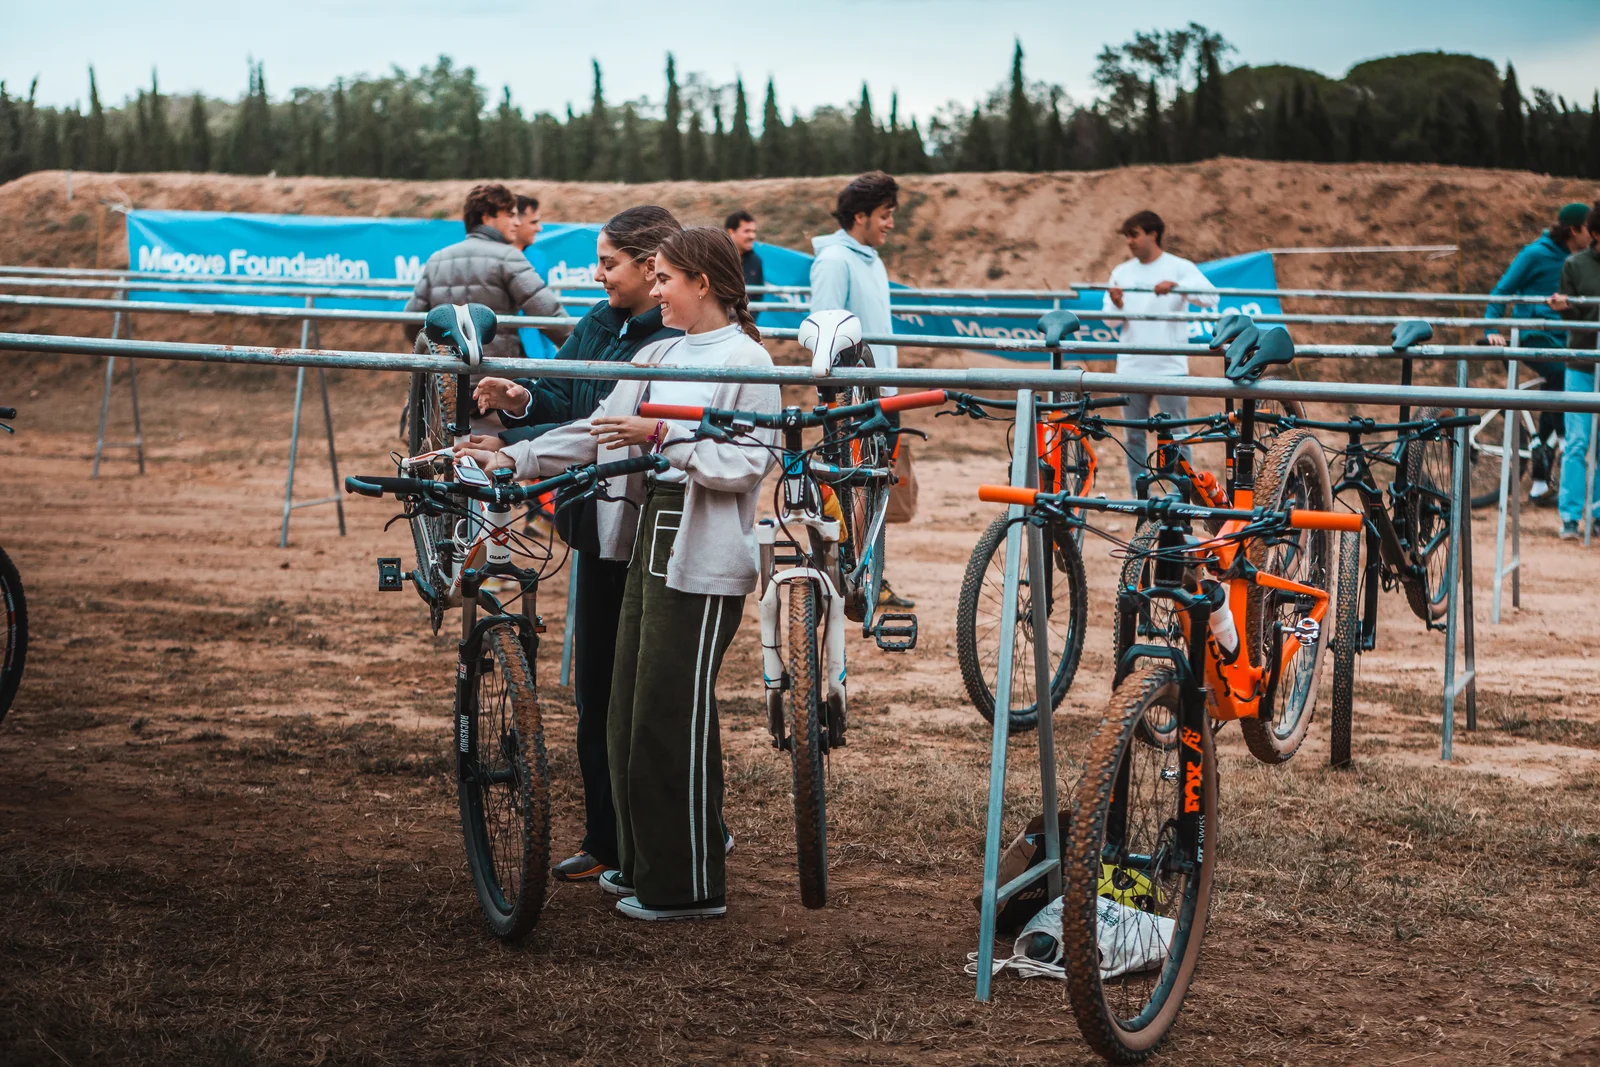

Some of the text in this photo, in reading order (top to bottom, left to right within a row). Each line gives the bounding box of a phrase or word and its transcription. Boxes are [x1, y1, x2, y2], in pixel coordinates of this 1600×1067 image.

[229, 249, 370, 280] Foundation
[460, 714, 469, 753] ROCKSHOX
[1184, 761, 1203, 813] FOX
[1198, 814, 1206, 843] SWISS
